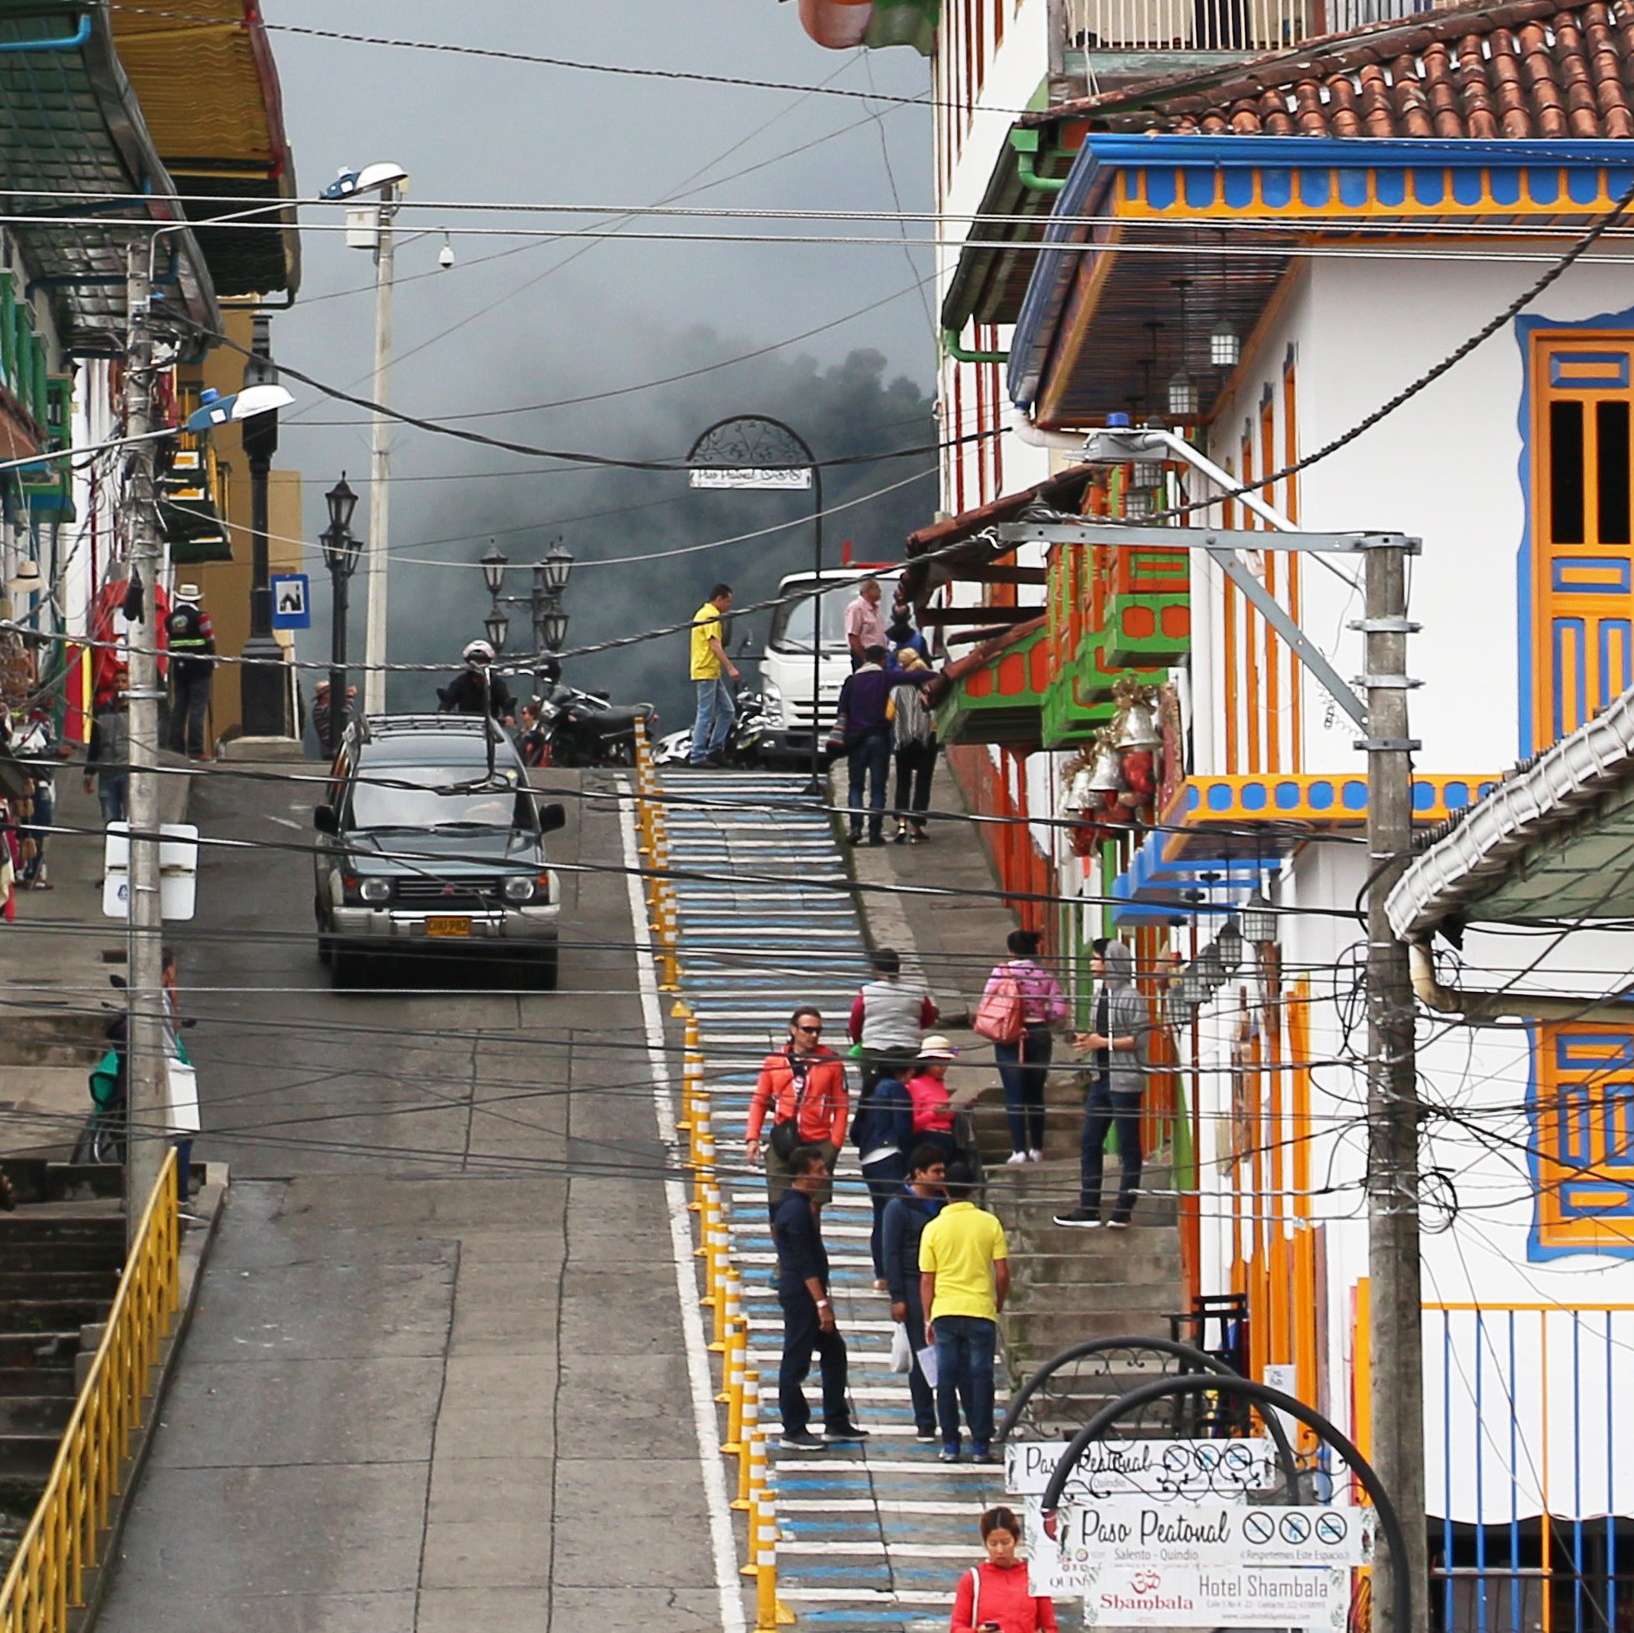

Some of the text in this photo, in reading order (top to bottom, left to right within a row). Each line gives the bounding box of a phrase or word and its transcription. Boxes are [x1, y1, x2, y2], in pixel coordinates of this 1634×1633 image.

[1026, 1446, 1058, 1478] Pas
[1081, 1509, 1231, 1546] Paso Peatonal
[1114, 1548, 1151, 1561] Salento
[1049, 1576, 1086, 1588] QUIN
[1199, 1574, 1328, 1598] Hotel Shambala
[1099, 1593, 1194, 1612] Shambala
